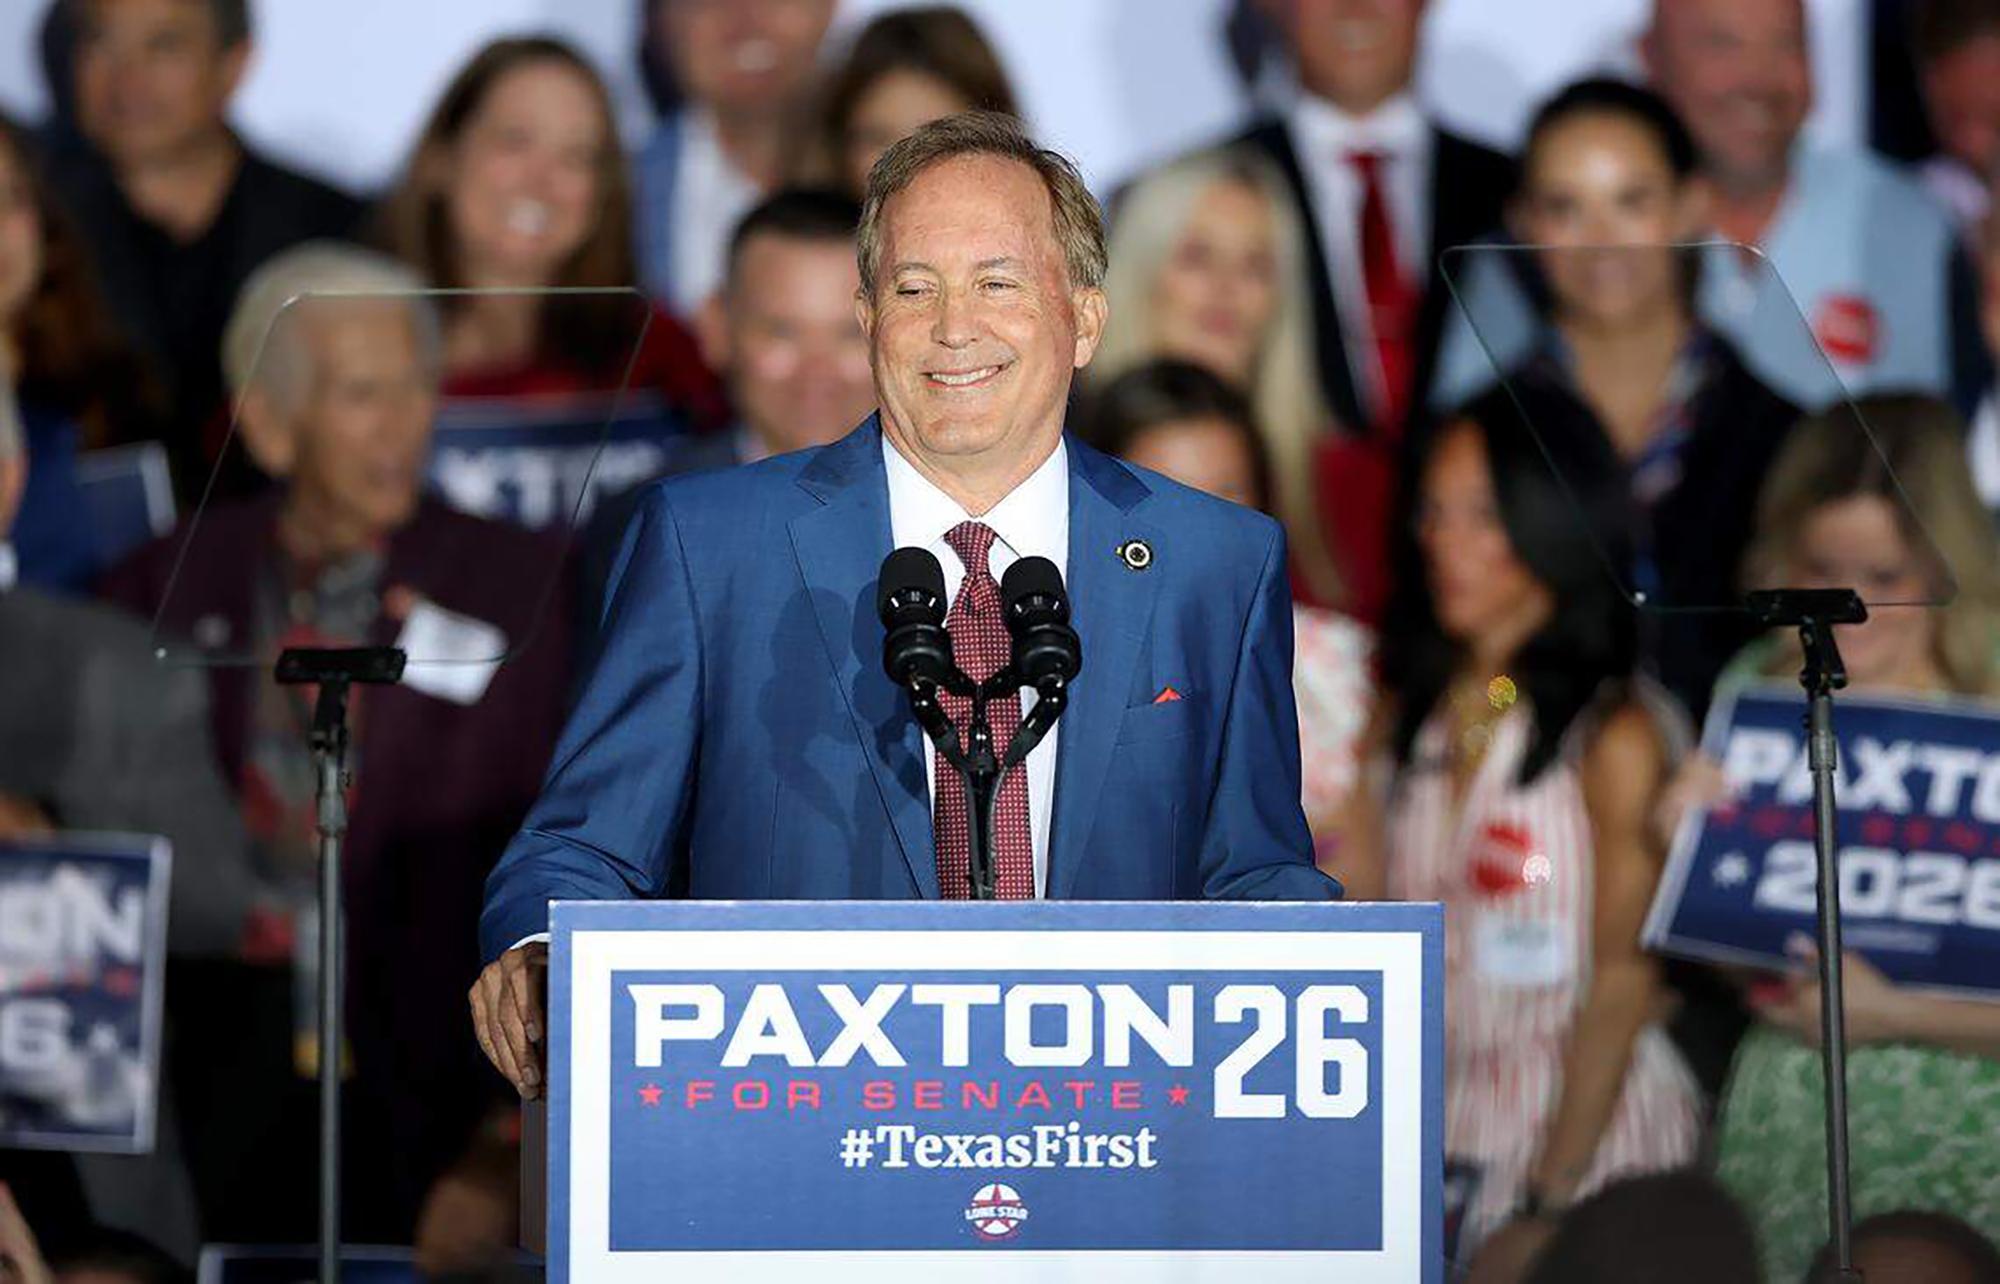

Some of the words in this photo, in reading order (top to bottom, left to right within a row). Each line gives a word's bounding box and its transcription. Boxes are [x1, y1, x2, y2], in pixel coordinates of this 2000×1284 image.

[627, 983, 1194, 1068] PAXTON
[1213, 984, 1369, 1119] 26
[686, 1080, 822, 1110] FOR
[863, 1080, 1144, 1110] SENATE
[839, 1120, 1158, 1169] #TexasFirst
